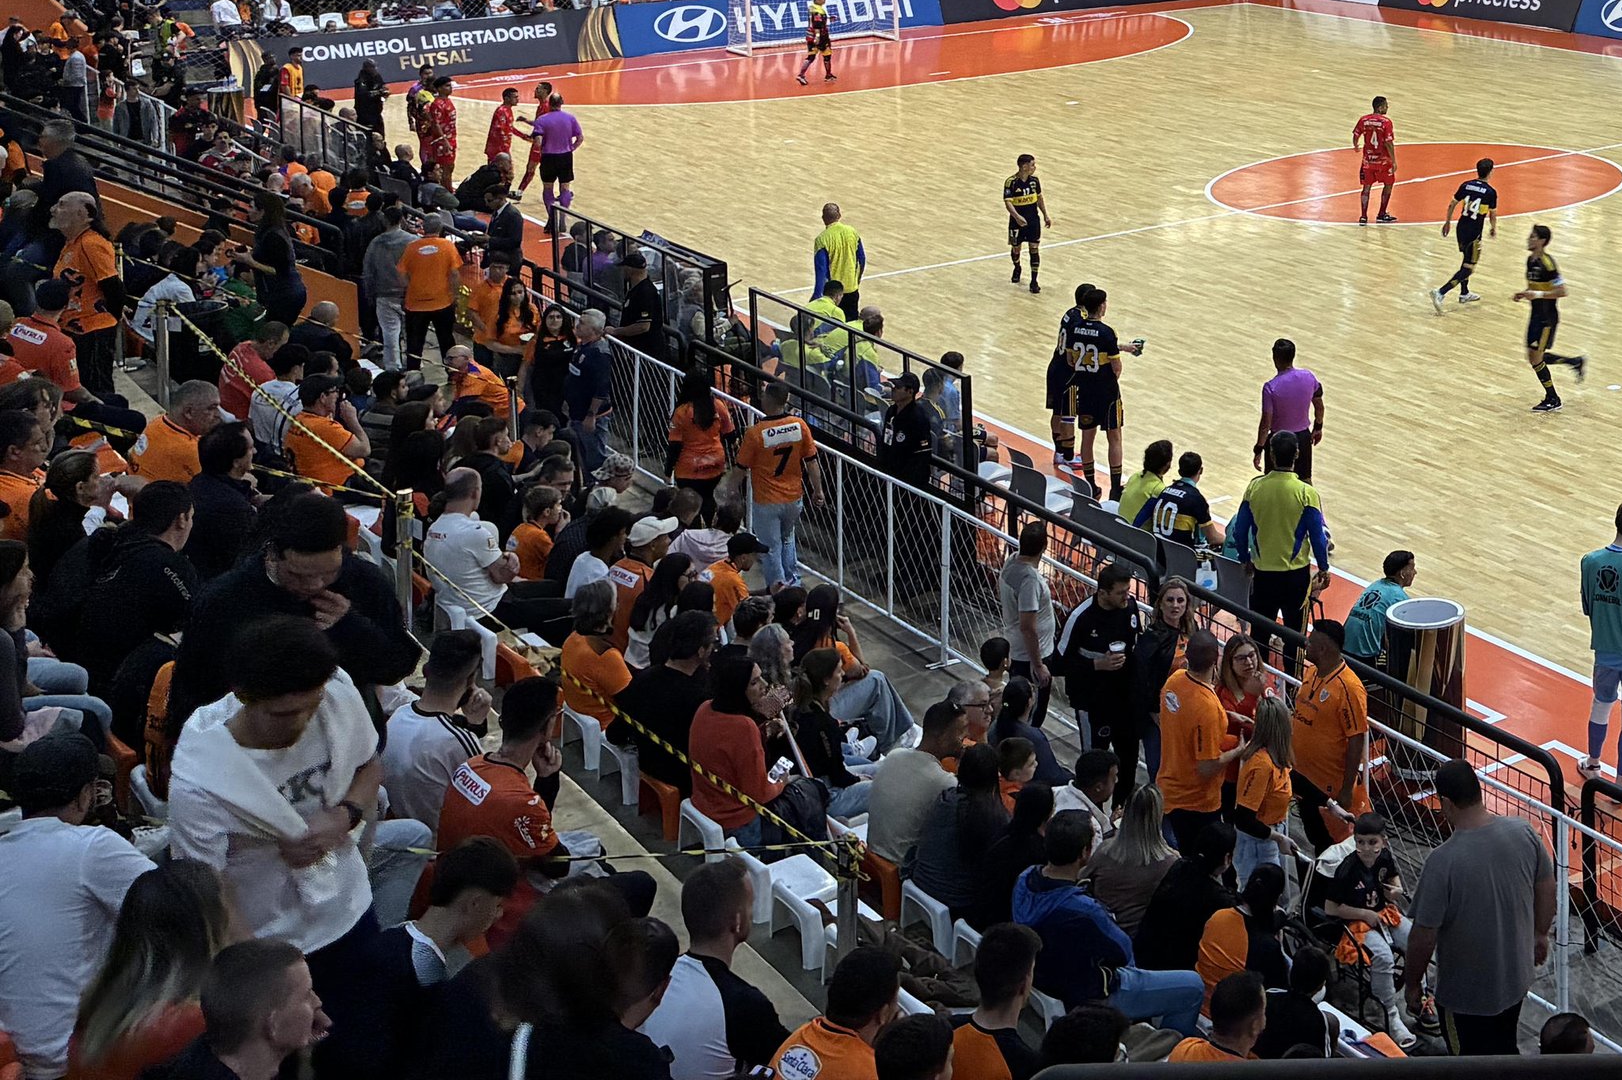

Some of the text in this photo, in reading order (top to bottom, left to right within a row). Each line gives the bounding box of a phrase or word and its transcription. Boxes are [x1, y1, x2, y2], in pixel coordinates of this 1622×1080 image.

[301, 23, 558, 62] CONMEBOL LIBERTADORES
[399, 49, 473, 70] FUTSAL
[1370, 130, 1379, 150] 4
[1462, 195, 1482, 220] 14
[1072, 341, 1100, 373] 23
[773, 445, 794, 477] 7
[1152, 498, 1179, 537] 10
[456, 770, 488, 800] PATRUS
